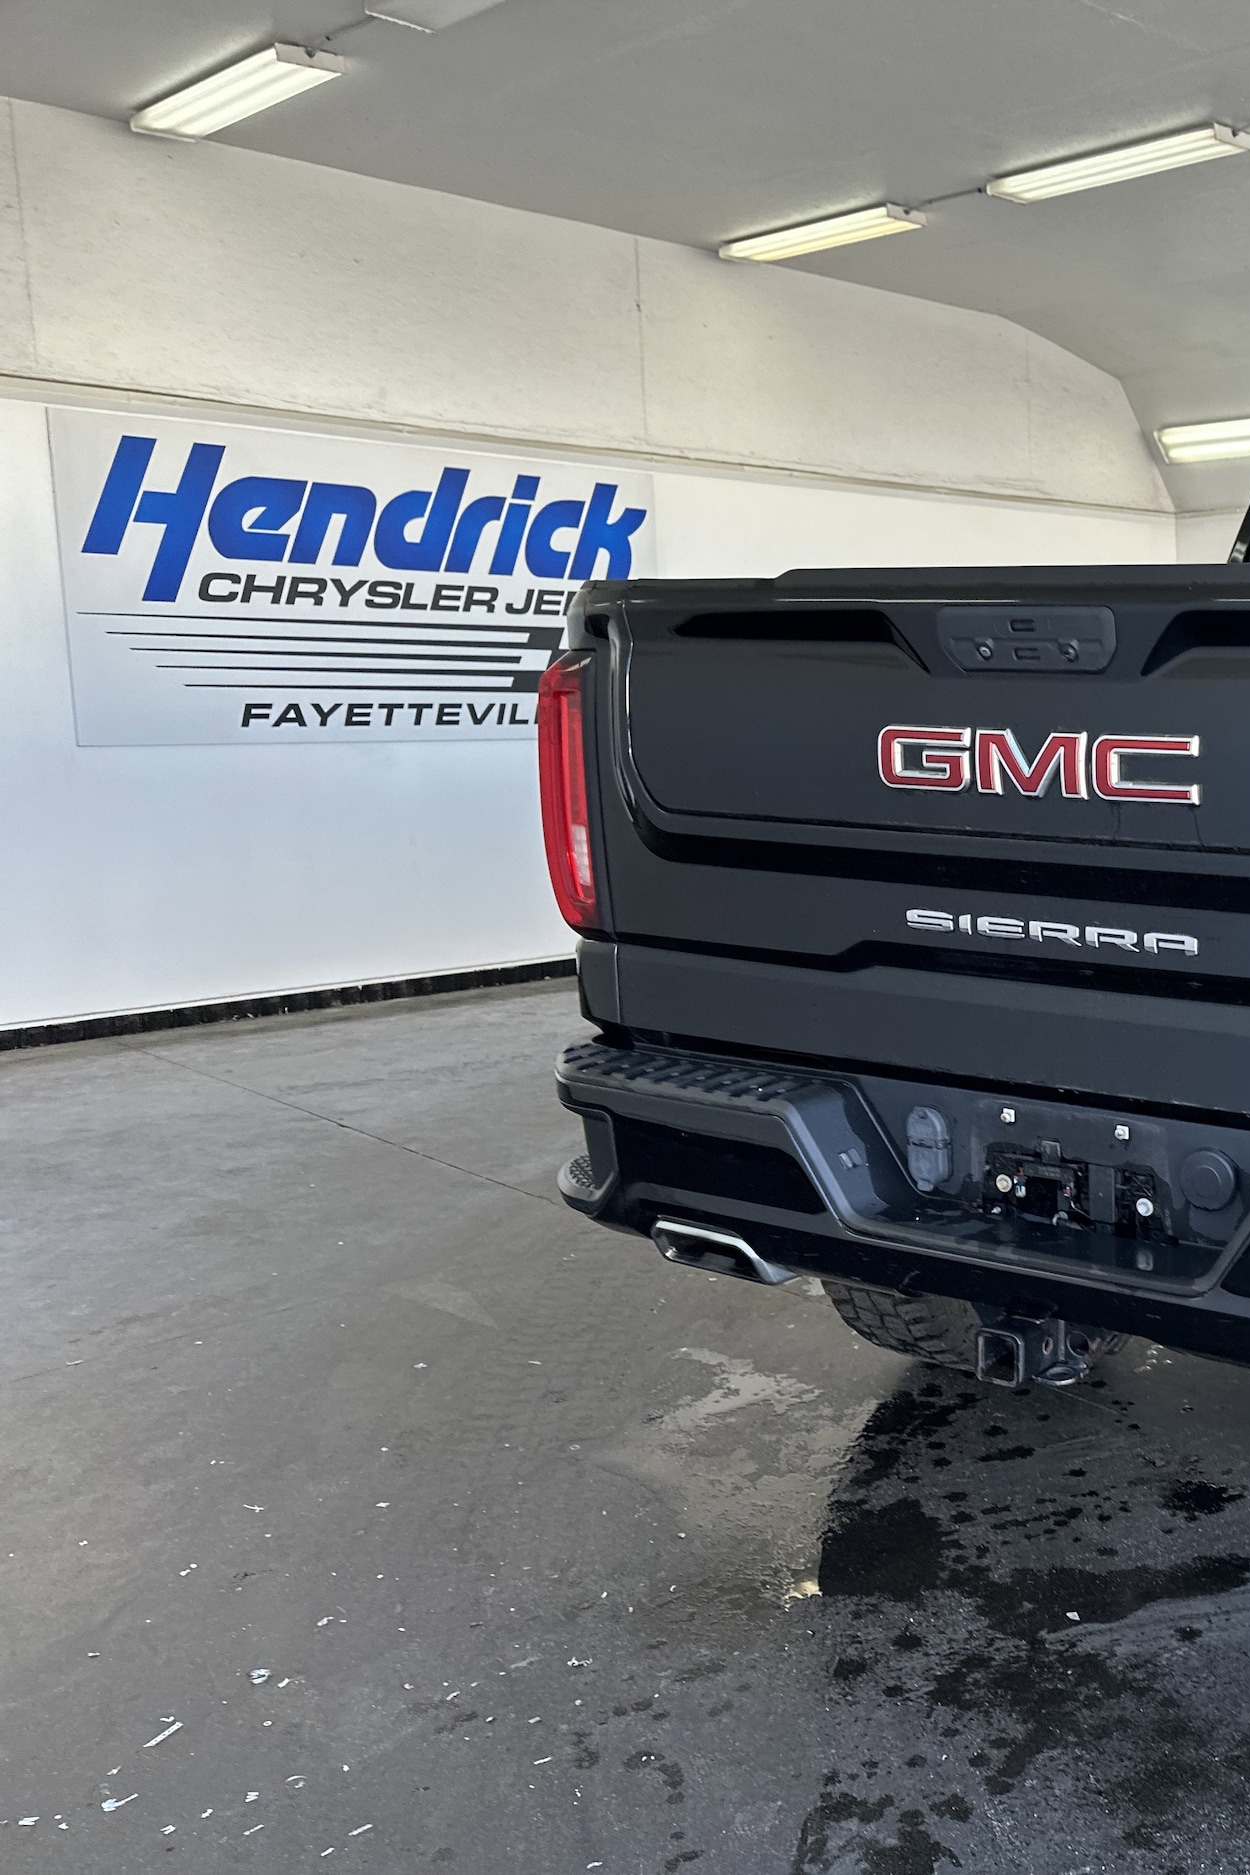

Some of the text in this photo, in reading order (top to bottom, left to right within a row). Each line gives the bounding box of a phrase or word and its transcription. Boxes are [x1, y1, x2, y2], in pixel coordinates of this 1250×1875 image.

[81, 435, 647, 602] Hendrick
[198, 572, 577, 616] CHRYSLER JE
[241, 702, 538, 727] FAYETTEVIL
[877, 725, 1200, 806] GMC
[905, 908, 1199, 956] SIERRA
